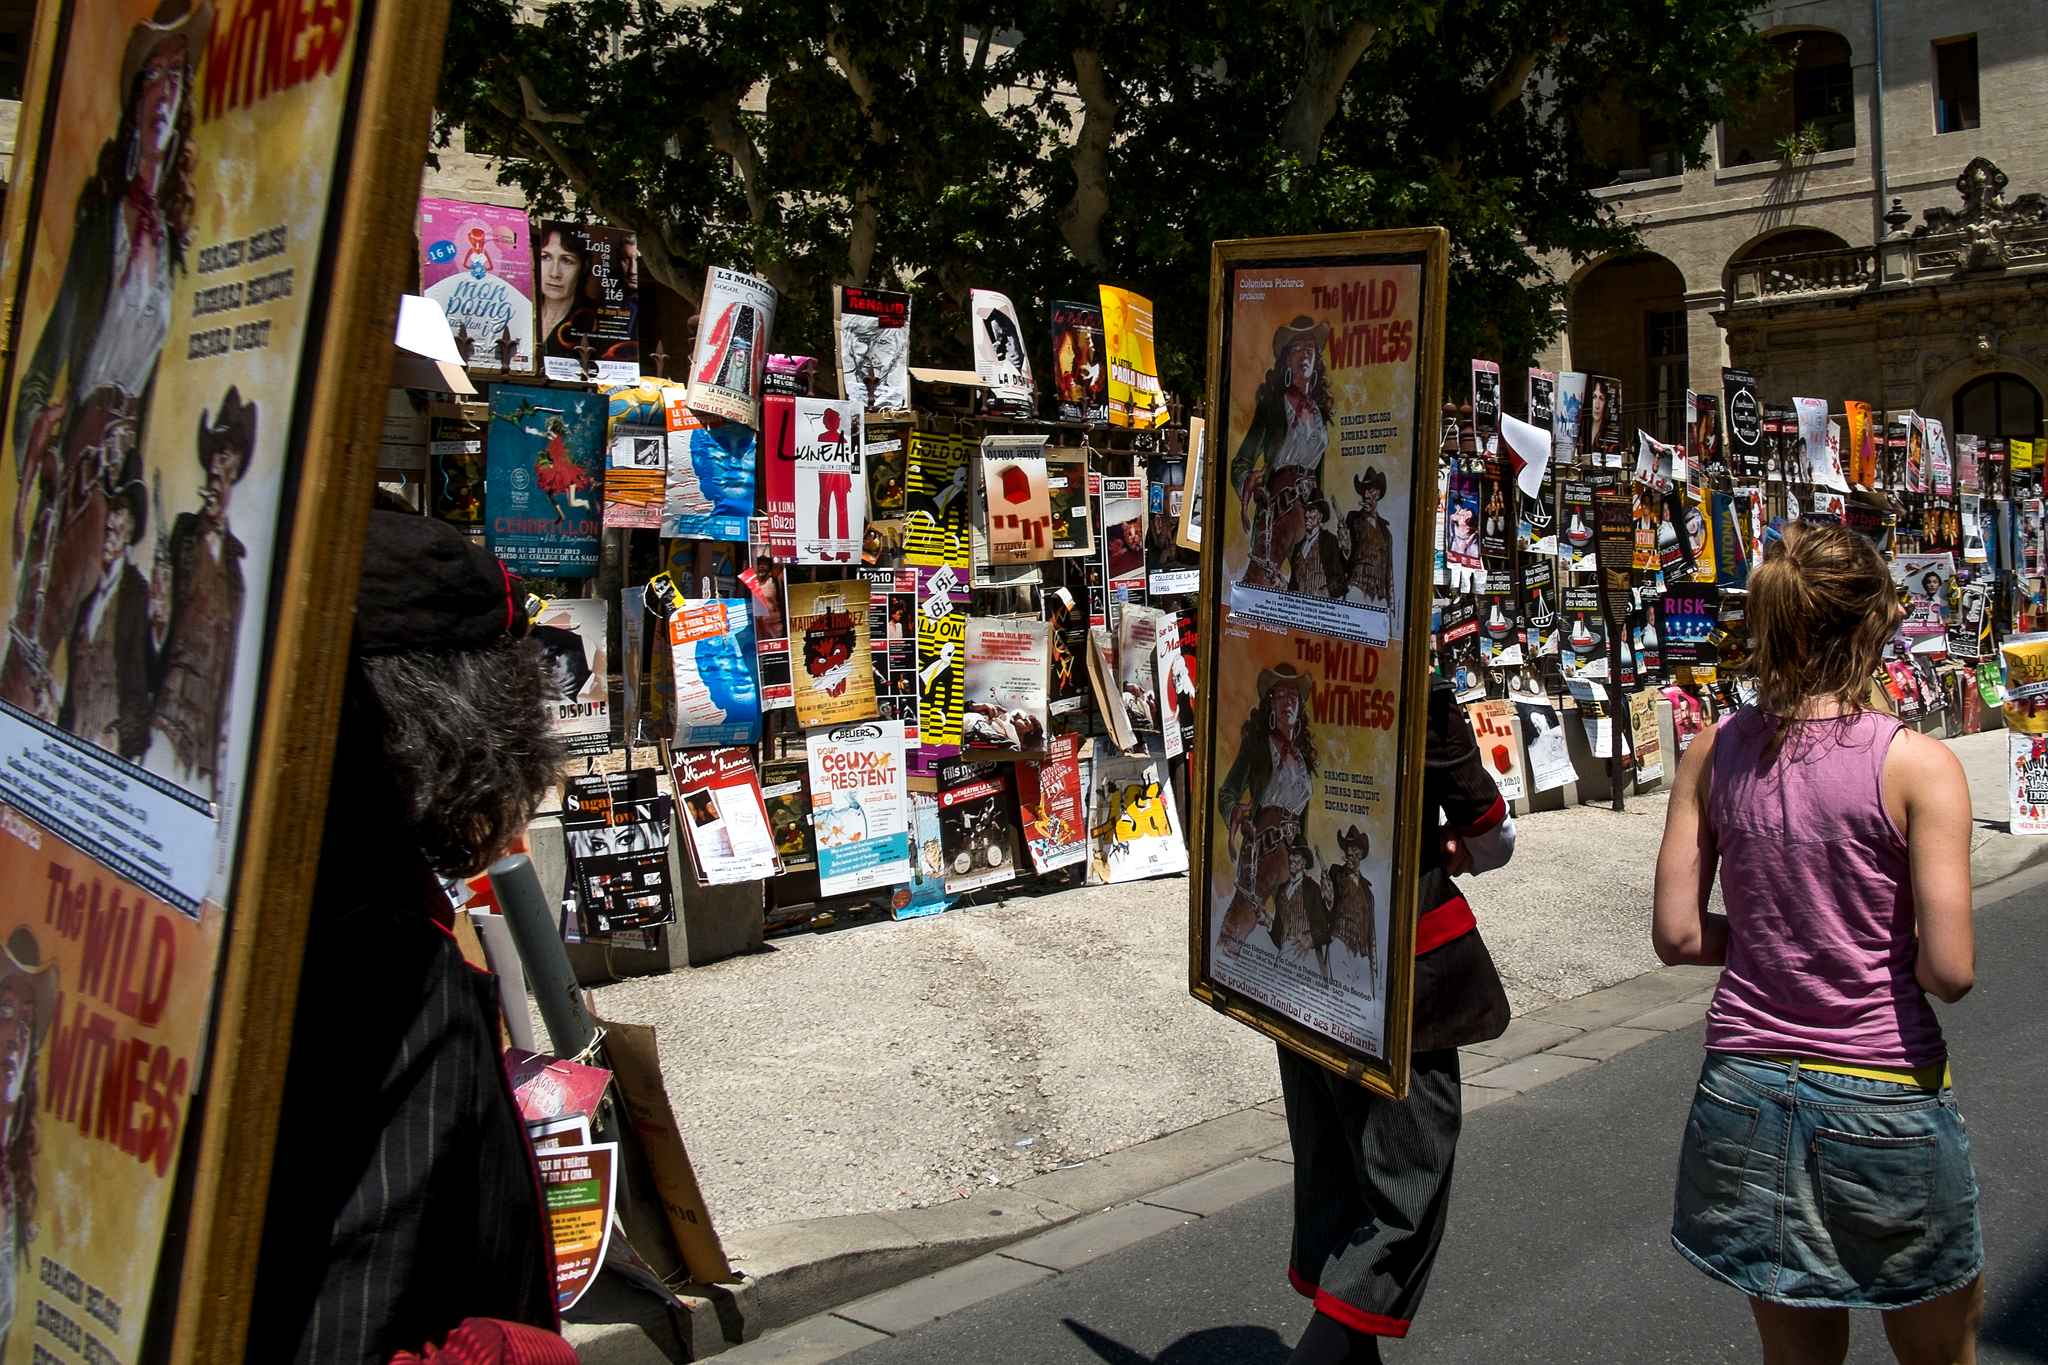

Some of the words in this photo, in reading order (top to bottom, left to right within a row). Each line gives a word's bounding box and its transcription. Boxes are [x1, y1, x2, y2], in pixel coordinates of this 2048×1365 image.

[430, 249, 443, 260] 16
[446, 244, 456, 254] H
[586, 240, 611, 254] Lois
[601, 252, 610, 260] de
[455, 281, 507, 300] mon
[1312, 286, 1339, 310] The
[1341, 279, 1397, 323] WILD
[446, 297, 514, 333] poing
[1328, 320, 1413, 370] WITNESS
[1111, 356, 1118, 366] LA
[999, 374, 1009, 385] LA
[693, 402, 710, 411] TOUS
[711, 405, 724, 414] LES
[910, 440, 949, 459] HOLD
[952, 447, 970, 463] ON
[769, 502, 779, 513] LA
[779, 502, 795, 514] LUNA
[862, 573, 891, 583] 12h10
[1665, 600, 1705, 614] RISK
[1296, 638, 1322, 664] The
[1323, 639, 1379, 685] WILD
[559, 702, 606, 719] DISPUTE
[1311, 681, 1395, 731] WITNESS
[817, 747, 838, 759] pour
[831, 768, 897, 790] RESTENT
[45, 860, 87, 941] The
[79, 876, 177, 1029] WILD
[1228, 976, 1269, 1001] production
[1303, 1013, 1313, 1023] et
[1313, 1018, 1329, 1031] ses
[45, 991, 187, 1178] WITNESS
